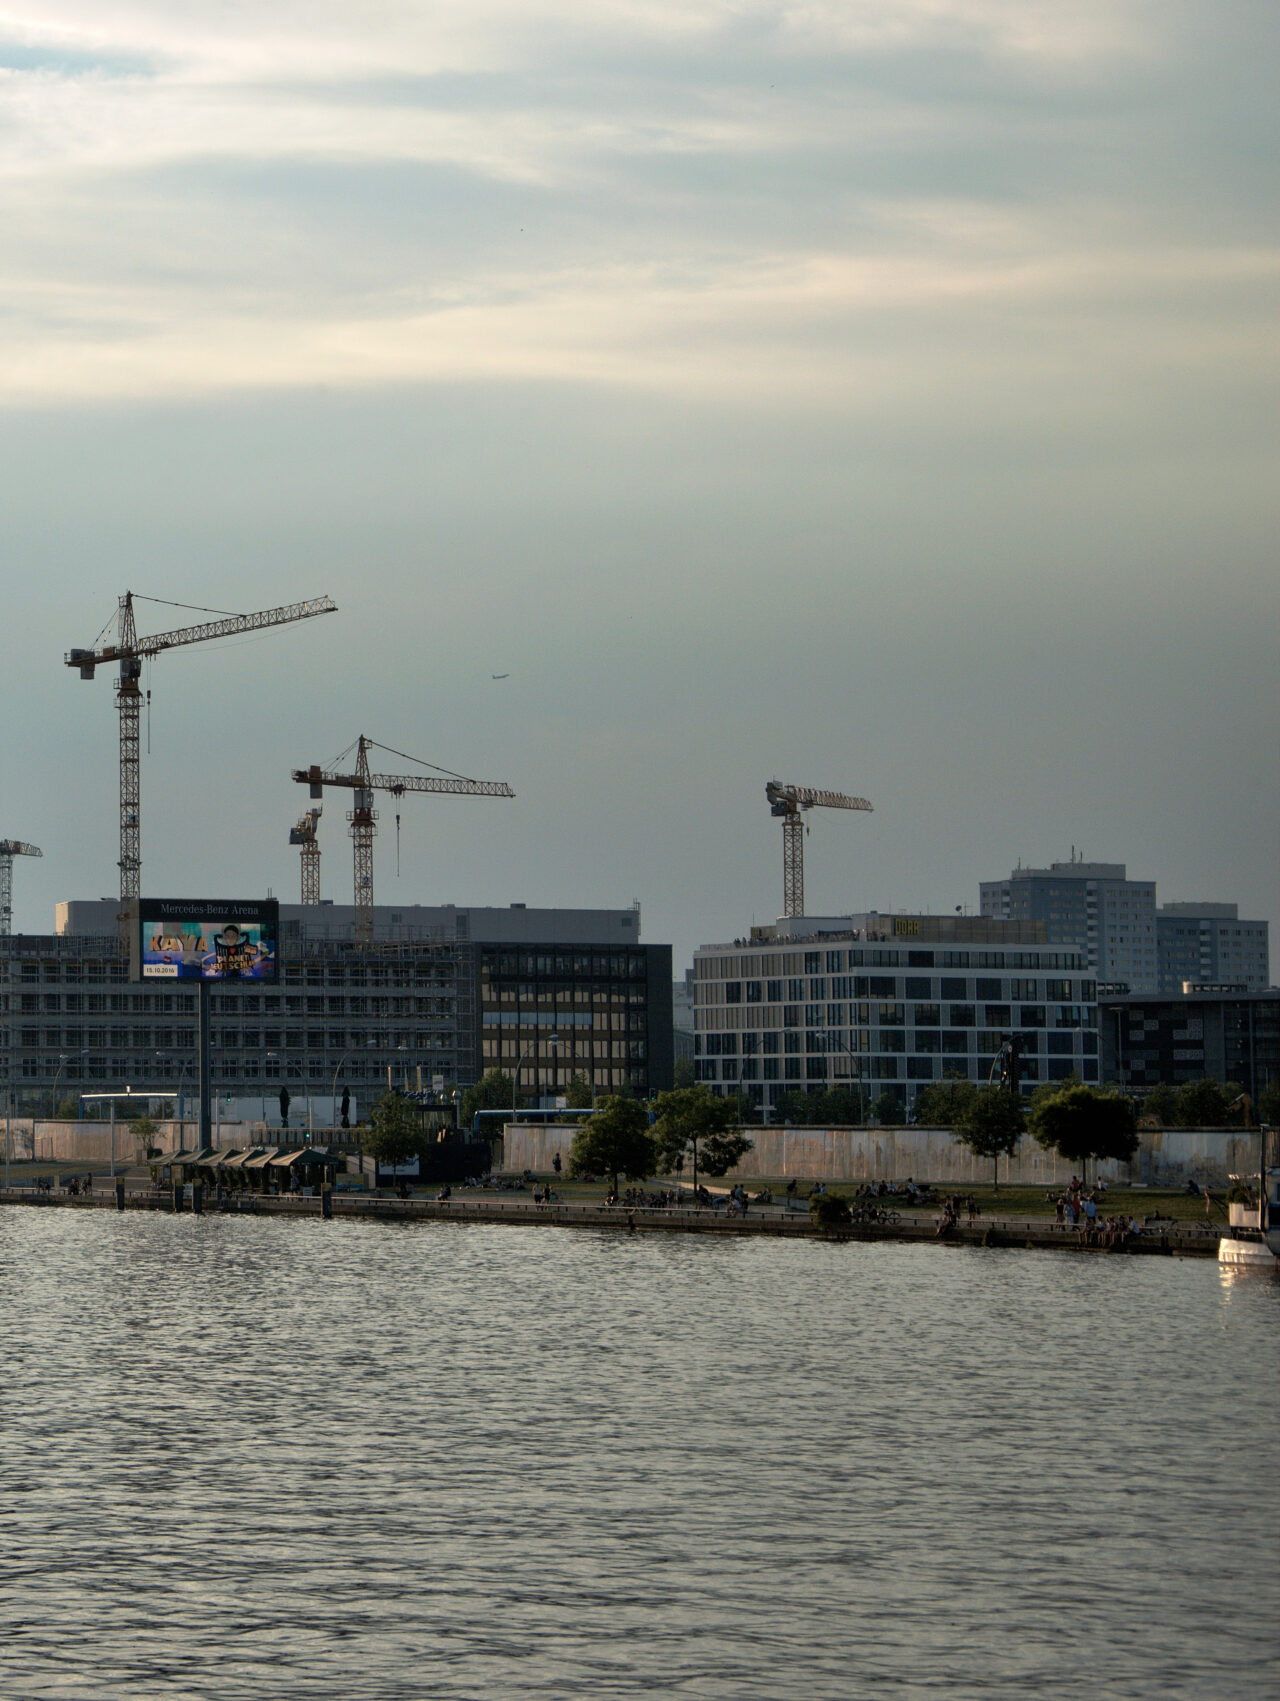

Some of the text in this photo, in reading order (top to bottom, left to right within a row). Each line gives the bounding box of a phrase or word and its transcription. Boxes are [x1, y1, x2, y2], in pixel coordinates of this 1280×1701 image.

[161, 903, 259, 915] Mercedes-Benz Arena
[150, 935, 208, 951] KAYA
